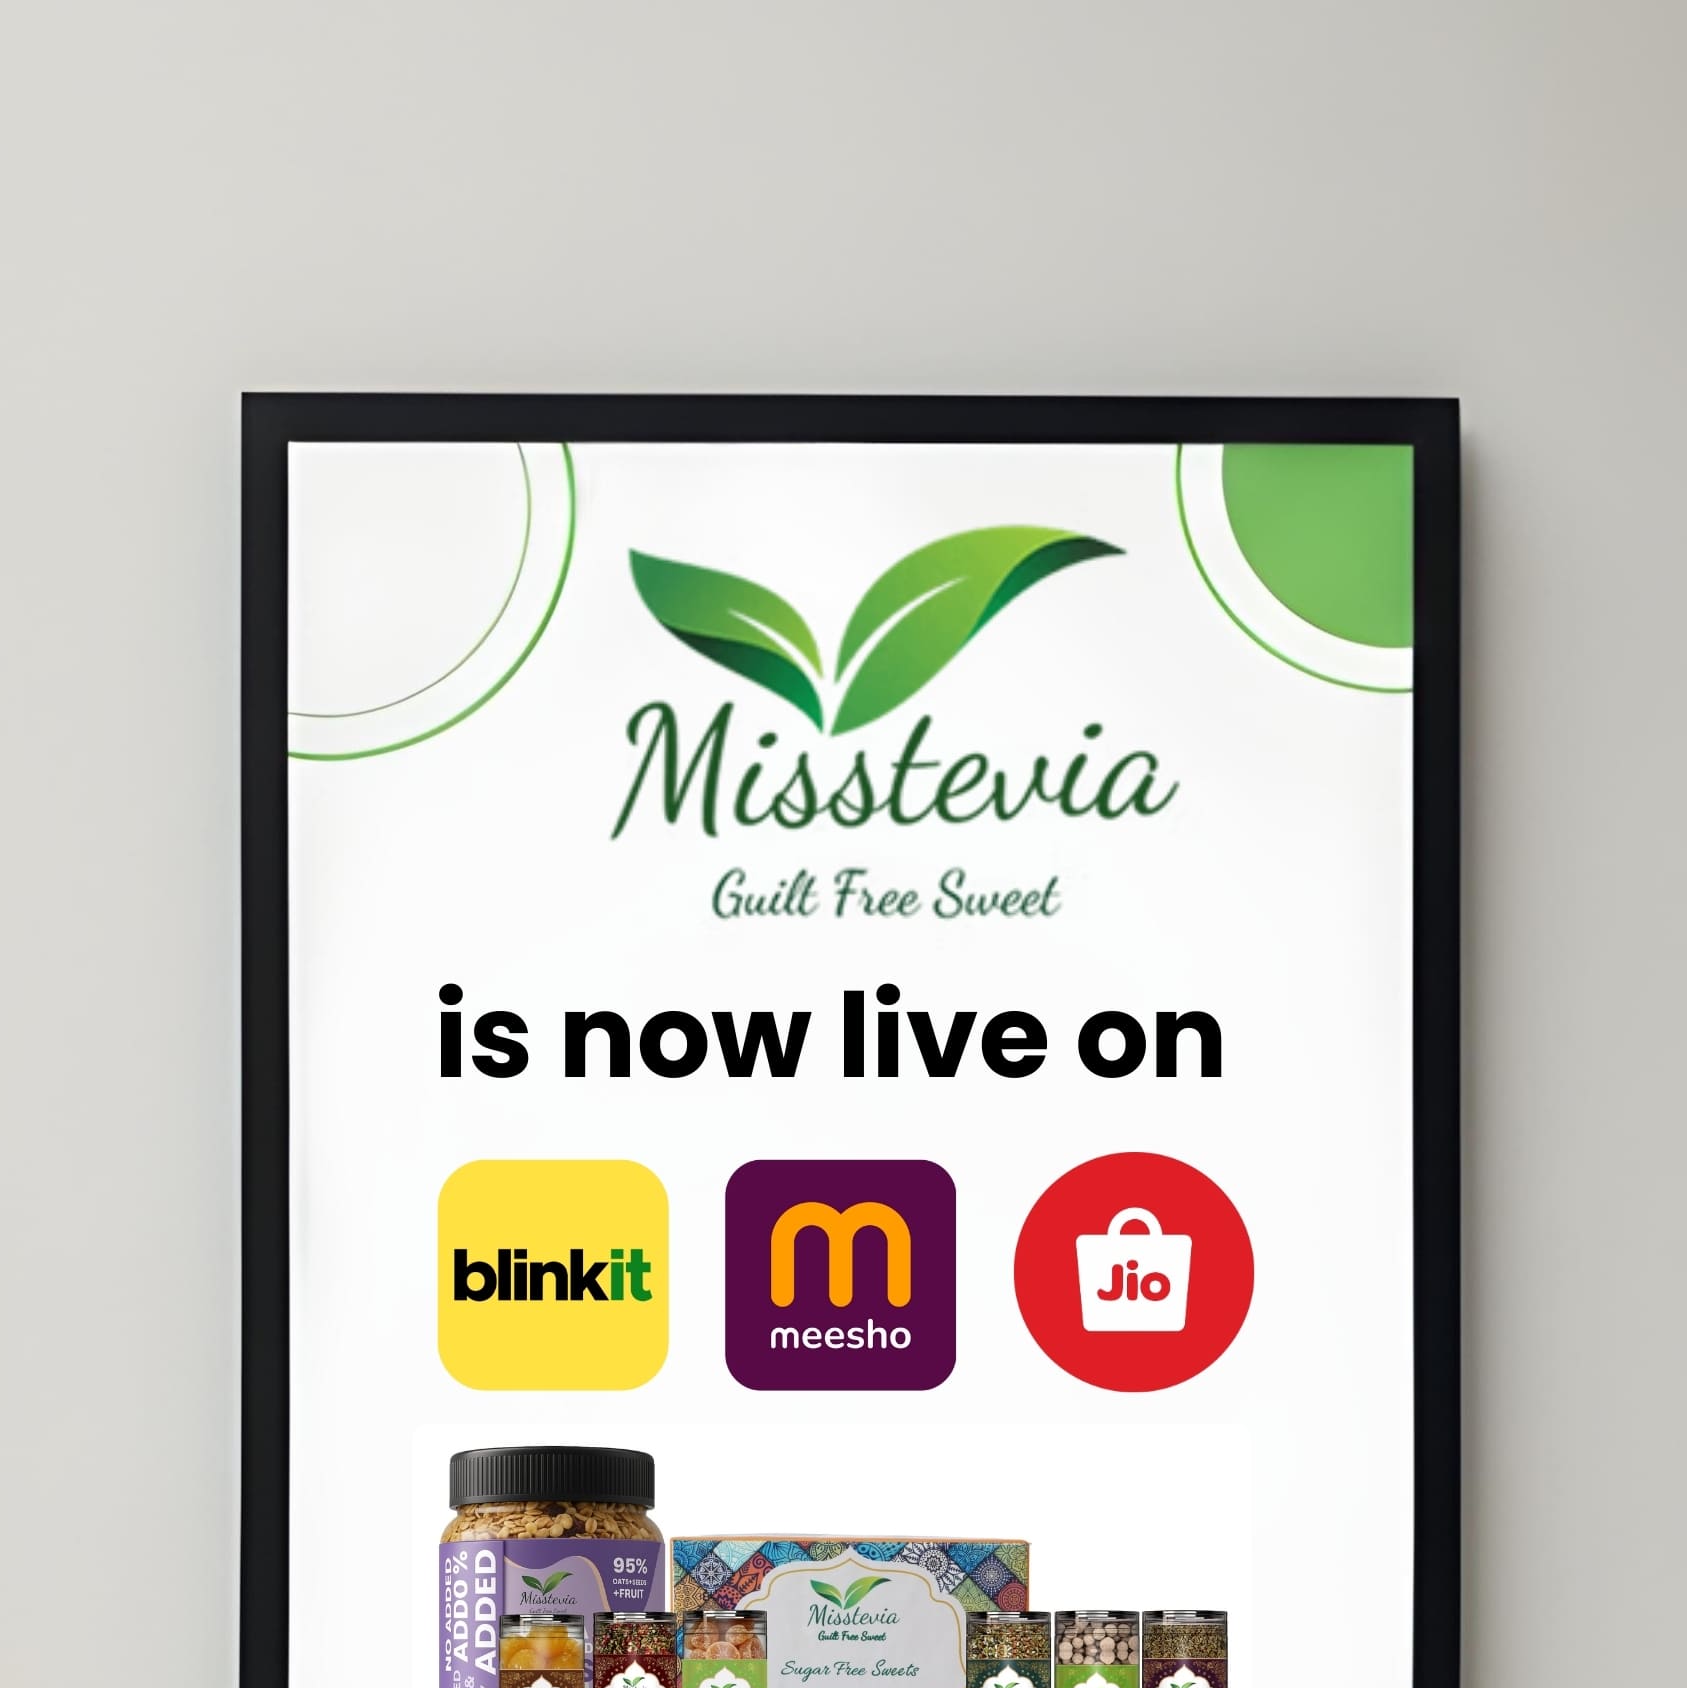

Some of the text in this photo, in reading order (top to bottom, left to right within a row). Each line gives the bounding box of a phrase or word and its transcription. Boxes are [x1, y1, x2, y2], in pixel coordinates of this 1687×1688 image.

[610, 699, 1181, 840] Misstevia
[712, 867, 1061, 919] Guilt Free Sweet
[439, 983, 1222, 1078] is now live on
[452, 1248, 653, 1303] blinkit
[1097, 1259, 1171, 1302] Jio
[771, 1319, 911, 1351] meesho
[613, 1557, 648, 1574] 95%
[520, 1592, 578, 1606] Misstevia
[613, 1588, 644, 1599] +FRUIT
[474, 1549, 497, 1676] ADDED
[807, 1604, 900, 1626] Misstevia
[841, 1630, 859, 1641] Free
[445, 1639, 452, 1672] NO
[780, 1659, 919, 1682] Sugar Free Sweets
